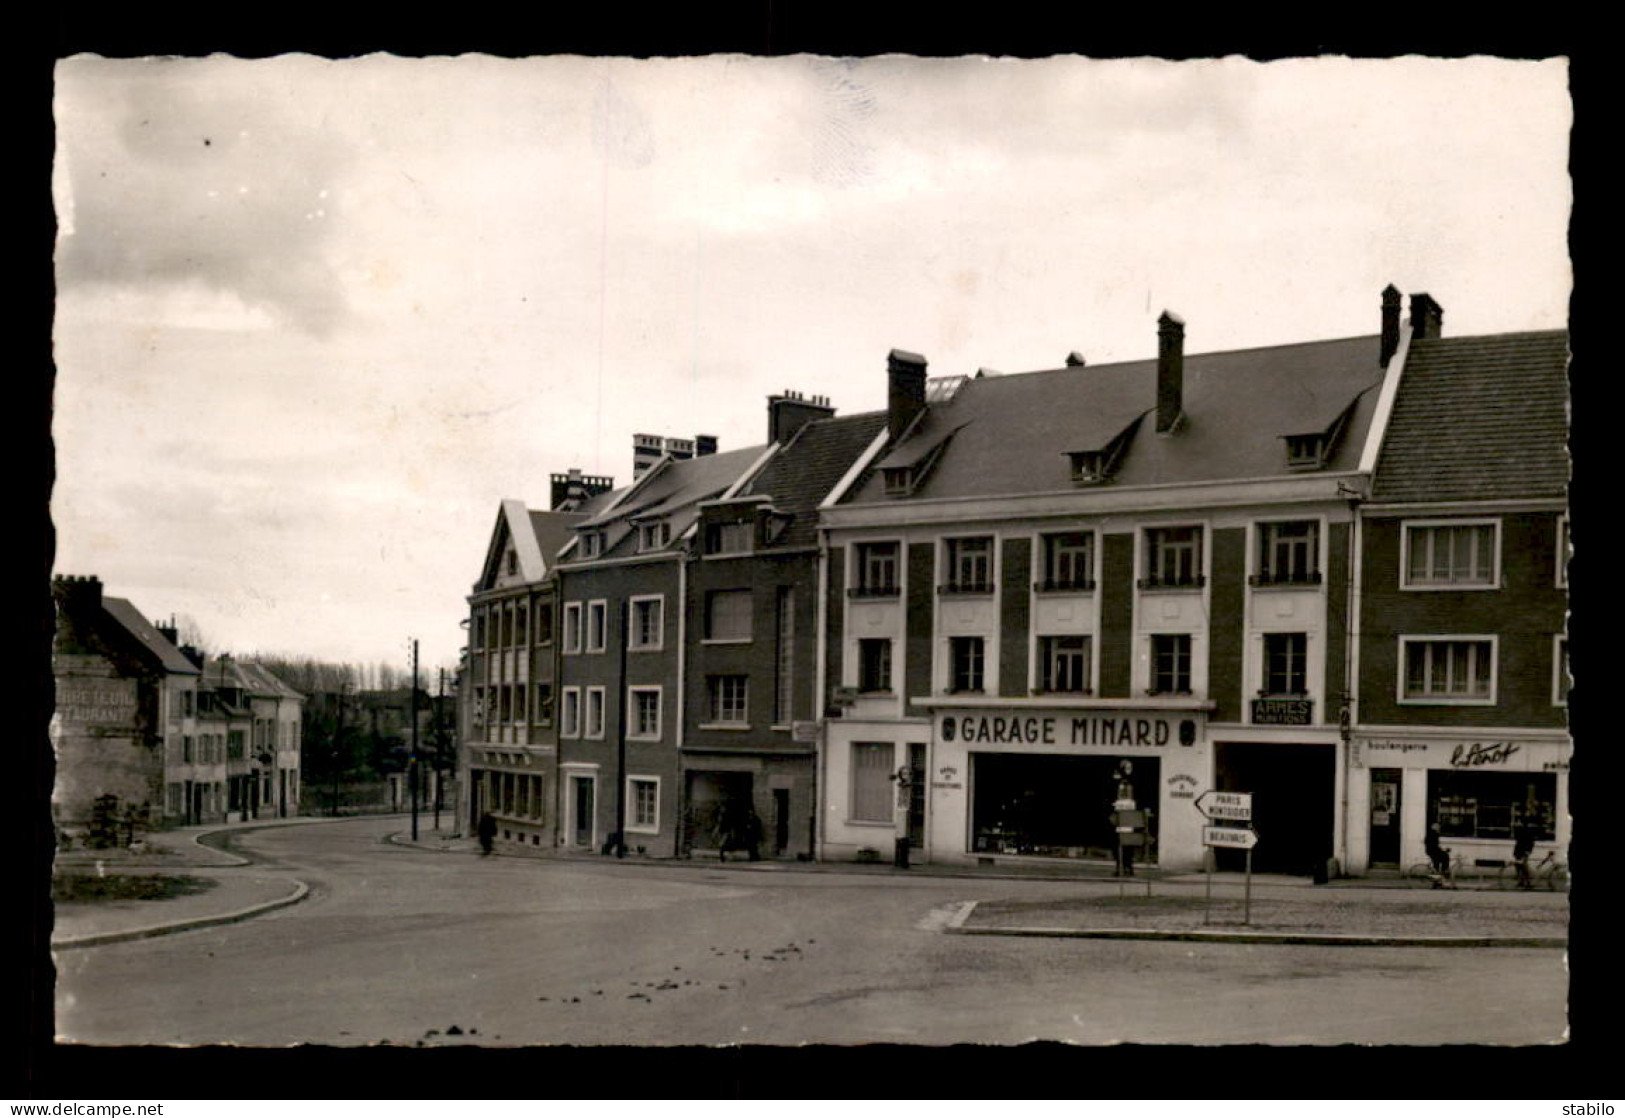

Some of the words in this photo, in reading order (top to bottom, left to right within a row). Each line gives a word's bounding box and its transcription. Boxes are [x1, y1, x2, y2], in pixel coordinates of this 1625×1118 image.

[1256, 701, 1307, 714] ARMES
[961, 716, 1056, 744] GARAGE
[1071, 717, 1170, 747] MINARD
[1369, 740, 1427, 753] boulangerie
[1217, 794, 1241, 806] PARIS
[1209, 831, 1247, 844] BEAUVAIS
